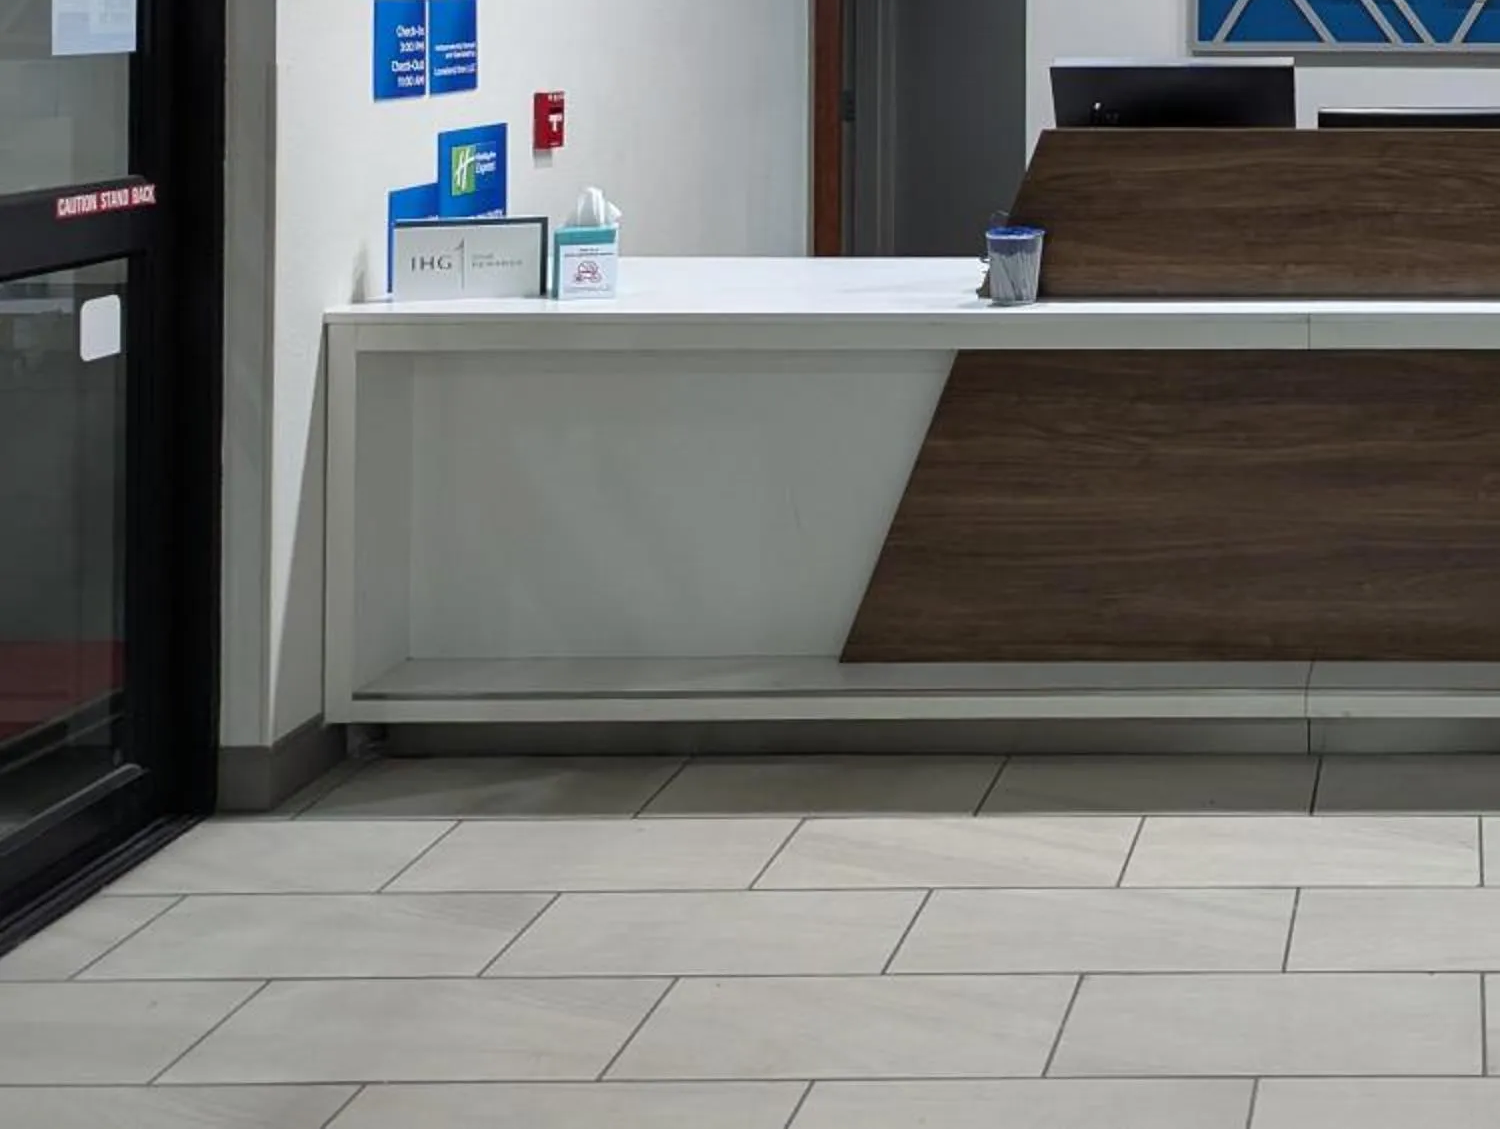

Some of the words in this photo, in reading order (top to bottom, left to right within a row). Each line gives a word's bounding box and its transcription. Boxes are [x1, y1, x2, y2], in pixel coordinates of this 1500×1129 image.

[57, 193, 97, 216] CAUTION
[101, 188, 129, 210] STAND
[130, 184, 156, 204] BACK
[410, 255, 453, 272] IHG
